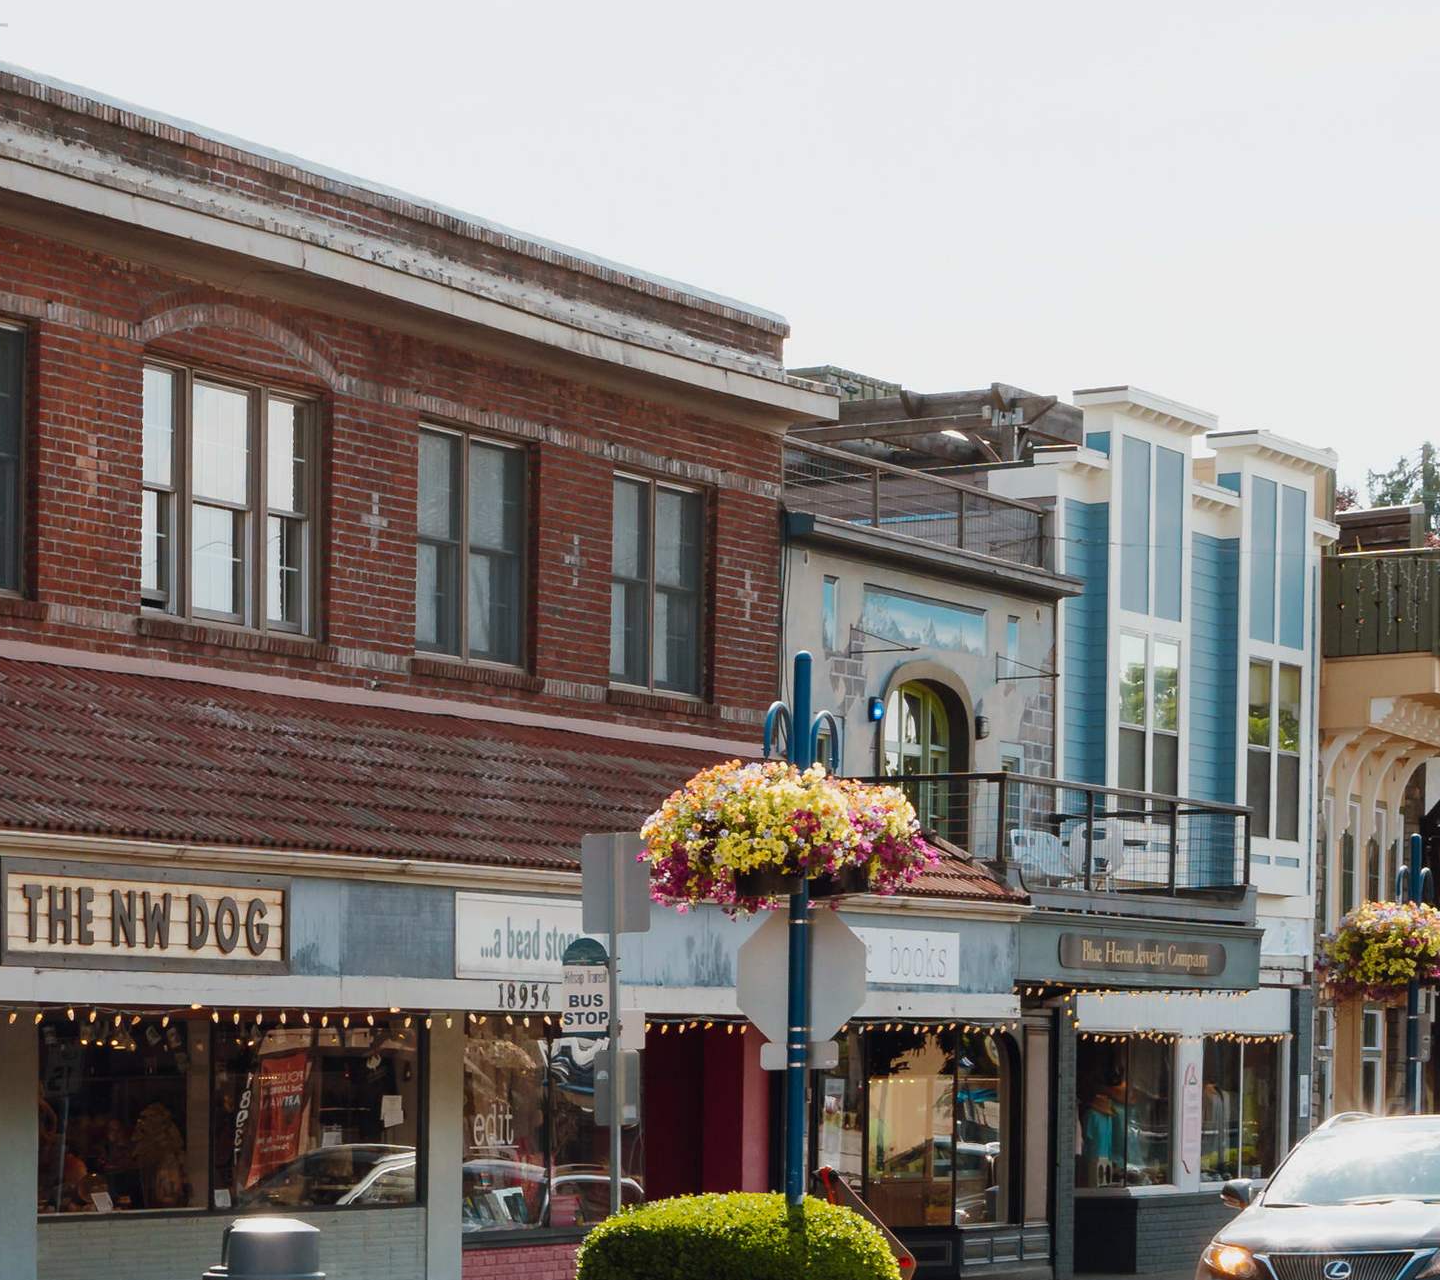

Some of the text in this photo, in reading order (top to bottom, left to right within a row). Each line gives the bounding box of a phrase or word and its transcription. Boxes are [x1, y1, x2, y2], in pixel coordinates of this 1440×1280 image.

[23, 884, 269, 956] THE NW DOG
[507, 916, 540, 961] bead
[889, 936, 946, 978] books
[1082, 940, 1208, 973] Blue Heron Jewelry Company
[587, 970, 607, 984] Transit
[498, 983, 550, 1009] 18954
[569, 994, 603, 1007] BUS
[564, 1012, 608, 1025] STOP
[473, 1103, 514, 1146] edit
